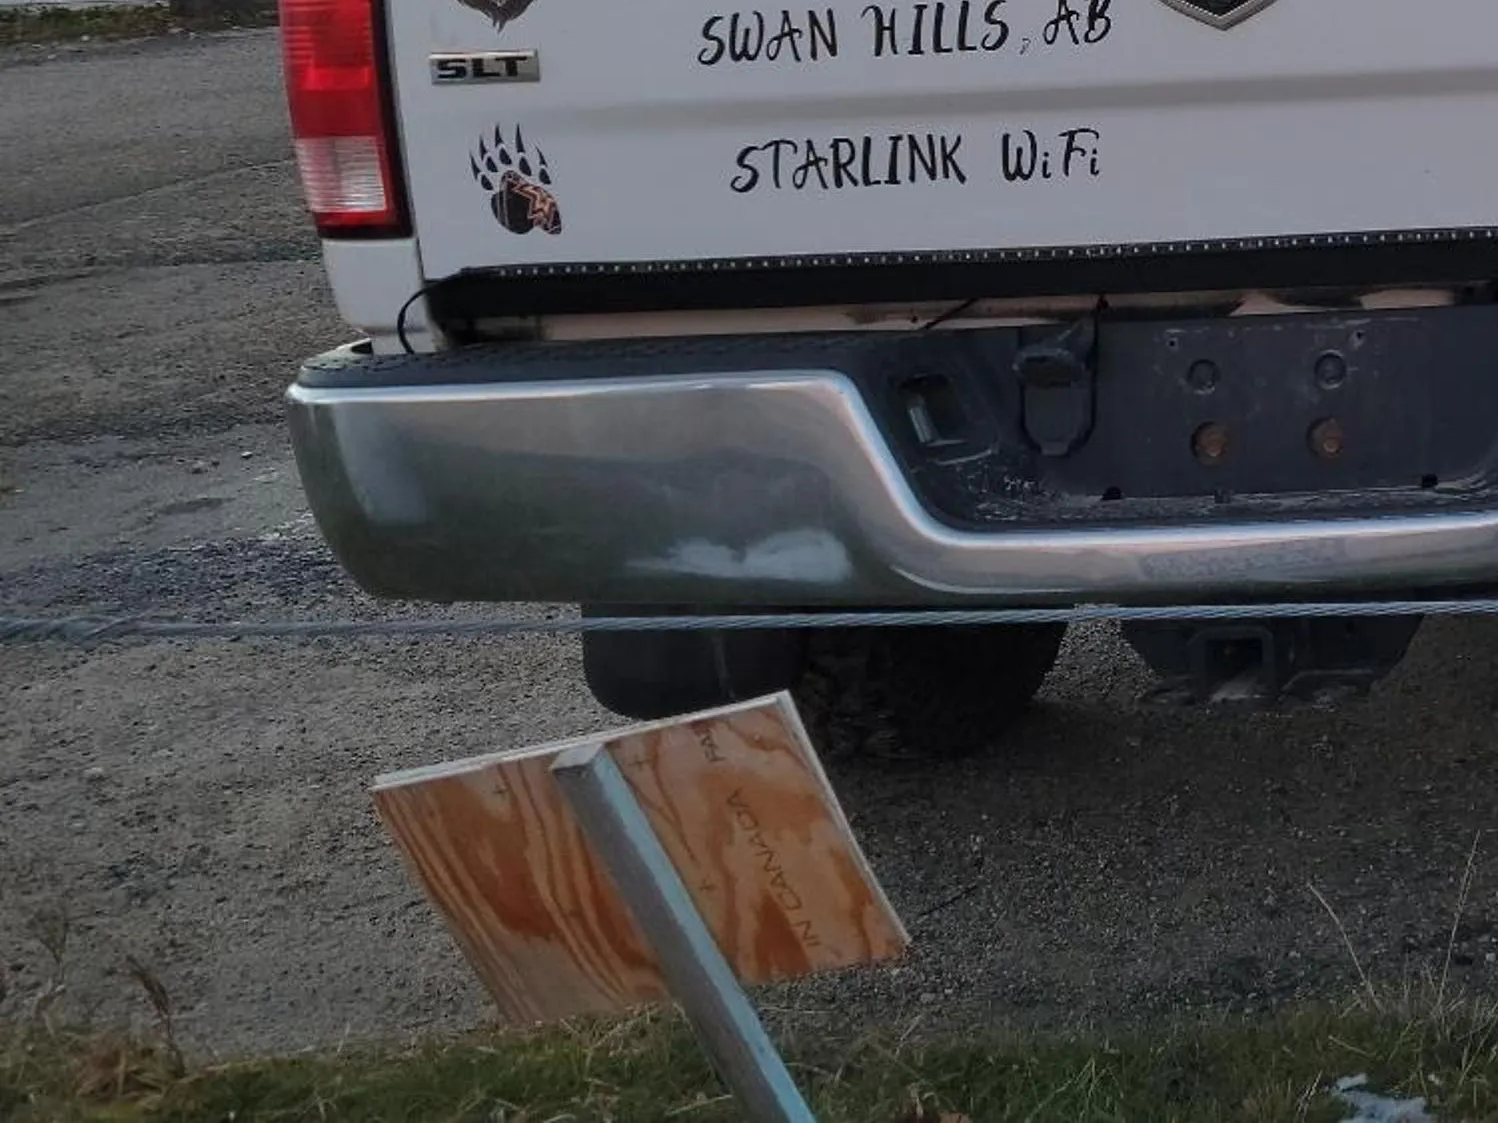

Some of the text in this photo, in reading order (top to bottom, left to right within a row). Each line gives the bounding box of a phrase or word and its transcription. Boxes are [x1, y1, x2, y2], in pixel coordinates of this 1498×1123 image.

[437, 55, 528, 79] SLT
[697, 7, 838, 67] SWAN
[729, 127, 1100, 194] STARLINK WiFi
[727, 787, 802, 910] CANADA
